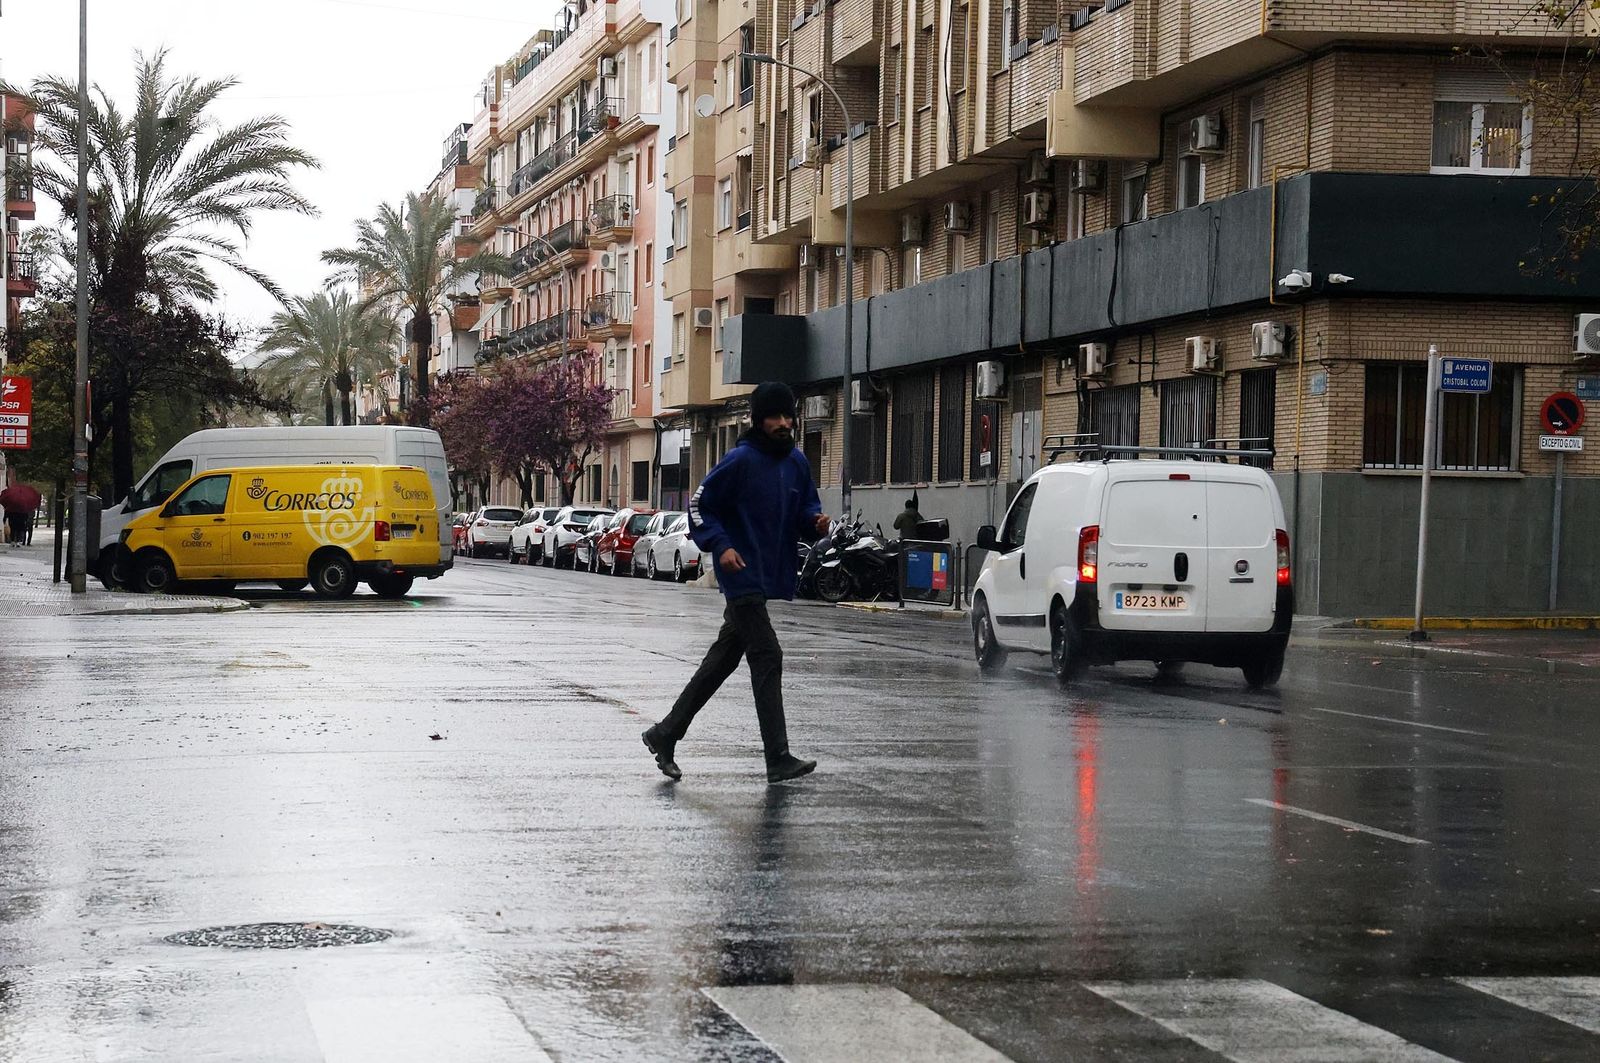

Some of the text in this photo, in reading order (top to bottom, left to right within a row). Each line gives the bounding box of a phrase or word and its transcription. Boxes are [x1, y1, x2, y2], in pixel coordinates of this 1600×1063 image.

[1443, 377, 1469, 386] CRISTOBAL
[1542, 438, 1564, 448] EXCEPTO
[401, 488, 429, 500] CORREOS
[264, 490, 356, 511] CORREOS
[182, 540, 212, 548] CORREOS
[1125, 595, 1184, 608] 8723 KMP
